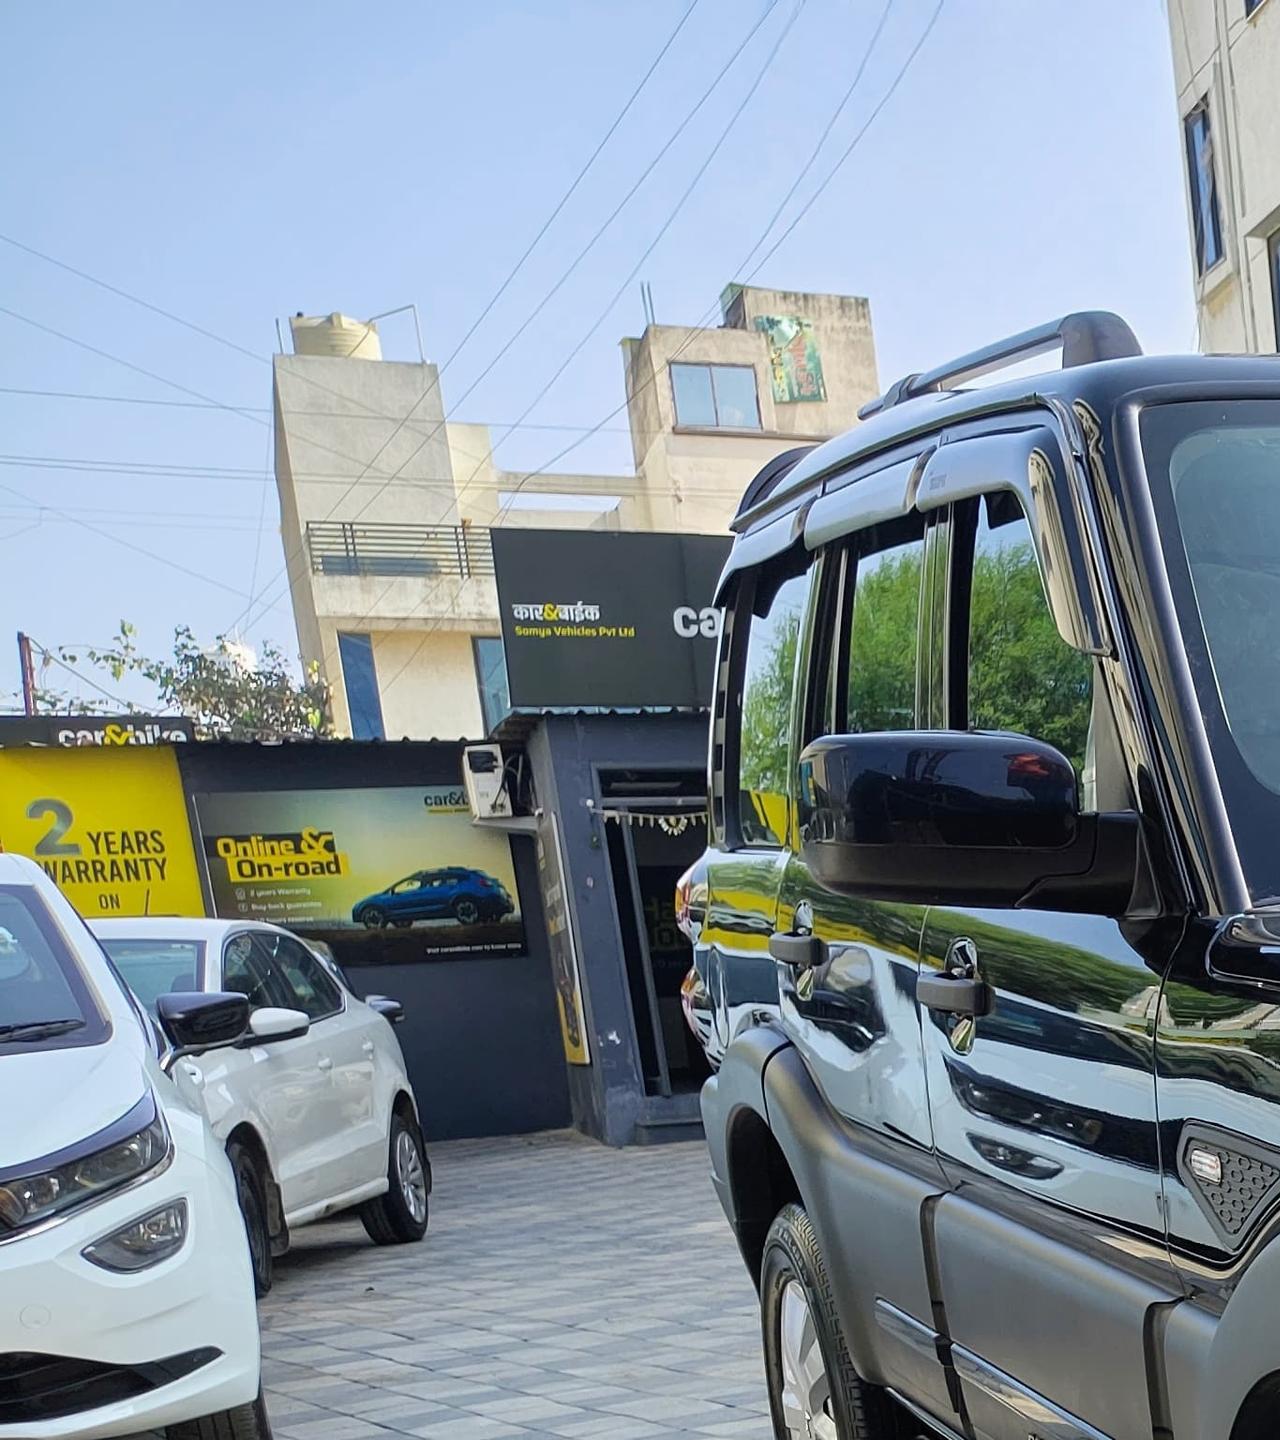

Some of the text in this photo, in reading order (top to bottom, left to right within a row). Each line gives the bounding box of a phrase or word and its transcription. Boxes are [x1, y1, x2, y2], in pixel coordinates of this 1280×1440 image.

[554, 625, 597, 637] Vehicles
[599, 626, 617, 637] Pvt
[618, 626, 636, 637] Ltd
[26, 798, 166, 856] 2 YEARS
[216, 826, 335, 859] Online &
[236, 853, 341, 879] On-road
[98, 893, 120, 910] ON
